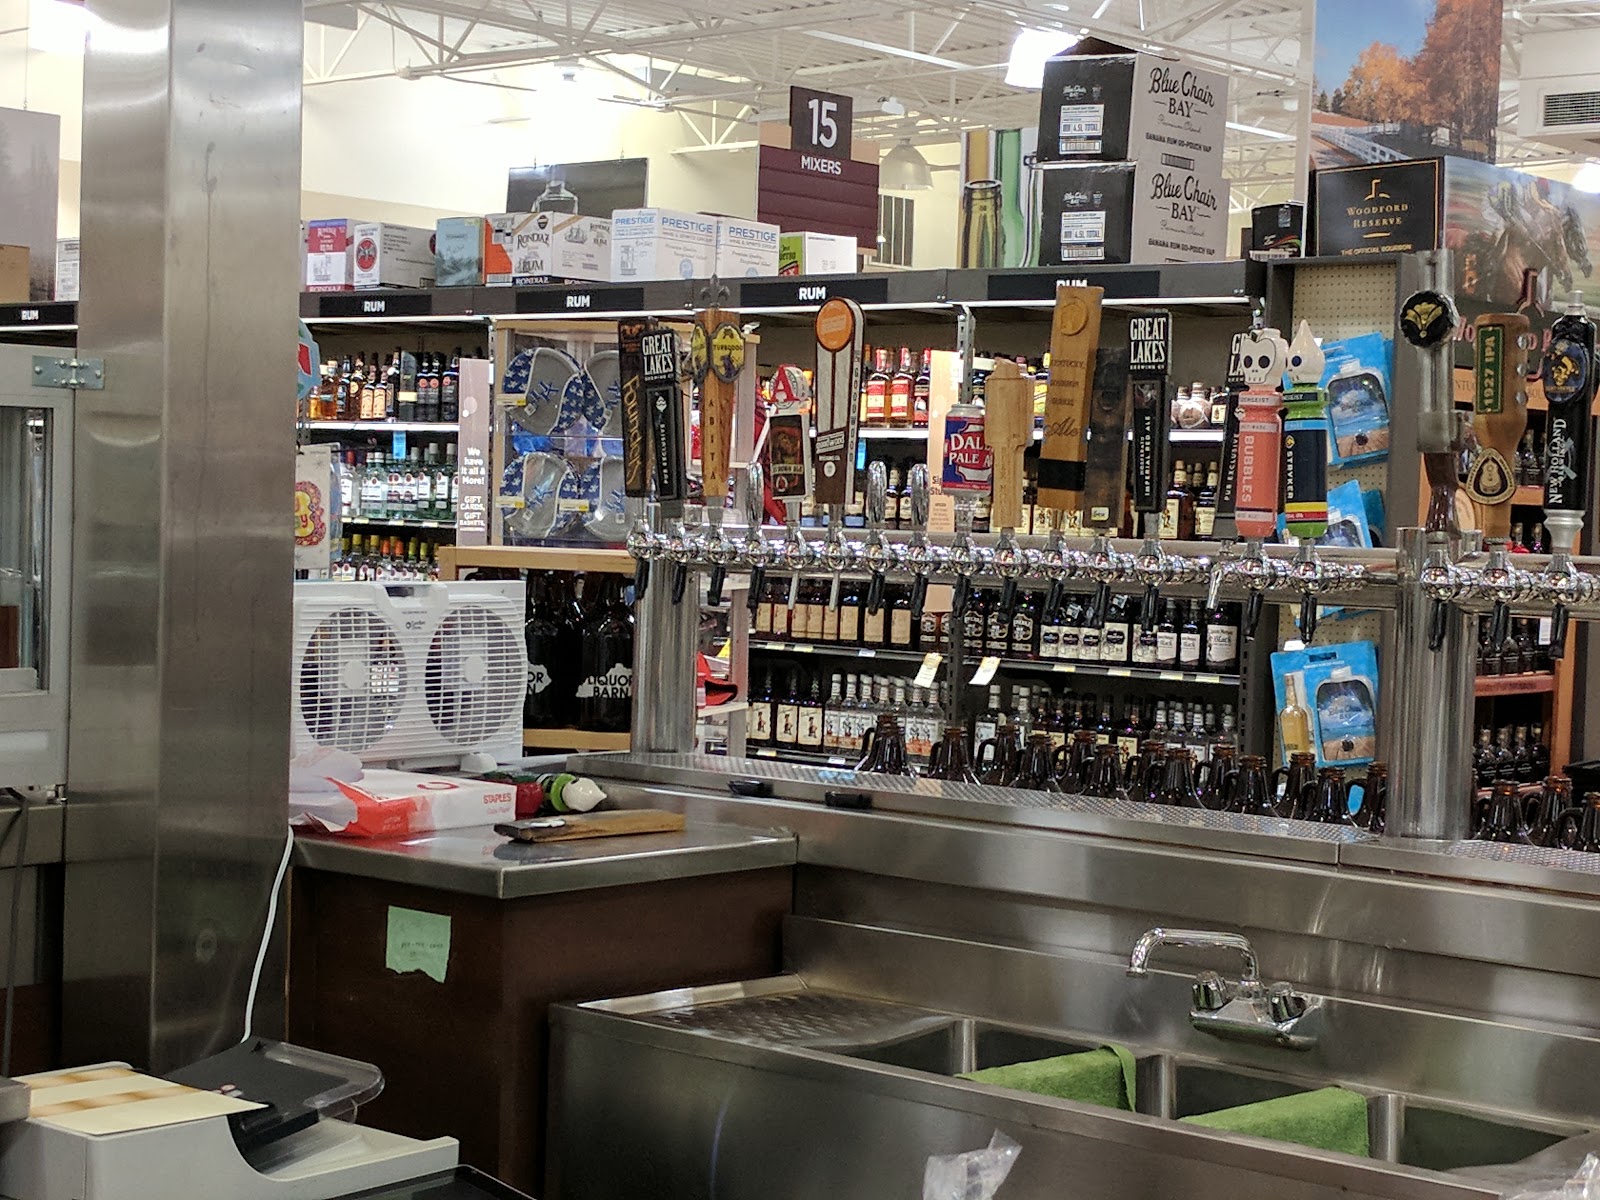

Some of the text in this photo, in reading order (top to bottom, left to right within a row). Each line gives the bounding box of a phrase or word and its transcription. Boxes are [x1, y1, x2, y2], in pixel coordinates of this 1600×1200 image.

[1148, 67, 1215, 108] Blue Chair
[1168, 97, 1194, 118] BAY
[808, 98, 838, 148] 15
[801, 155, 842, 175] MIXERS
[1150, 172, 1218, 211] Blue Chair
[1171, 202, 1196, 222] BAY
[1346, 203, 1408, 216] WOODFORD
[615, 216, 655, 225] PRESTIGE
[661, 216, 713, 234] PRESTIGE
[1353, 217, 1402, 229] RESERVE
[517, 232, 550, 250] RONDIAZ
[728, 226, 777, 241] PRESTIGE
[521, 259, 544, 273] RUM
[566, 295, 591, 308] RUM
[798, 286, 827, 300] RUM
[21, 309, 39, 321] RUM
[363, 300, 385, 312] RUM
[1130, 317, 1166, 340] GREAT
[642, 333, 672, 355] GREAT
[1130, 340, 1166, 363] LAKES
[643, 353, 673, 375] LAKES
[1483, 336, 1496, 406] 1927 IPA
[1045, 416, 1079, 437] Ale
[708, 400, 716, 480] ABITA
[467, 447, 481, 456] We
[949, 452, 980, 465] PALE
[1223, 433, 1240, 501] PUB EXCLUSIVE
[1242, 435, 1255, 503] BUBBLES
[1549, 418, 1567, 504] NEW HOLLAND
[462, 476, 485, 485] More!
[1286, 450, 1294, 499] STRYKER
[464, 512, 481, 520] GIFT
[588, 675, 633, 687] LIQUO
[593, 687, 629, 698] BARN
[483, 792, 512, 804] STAPLES
